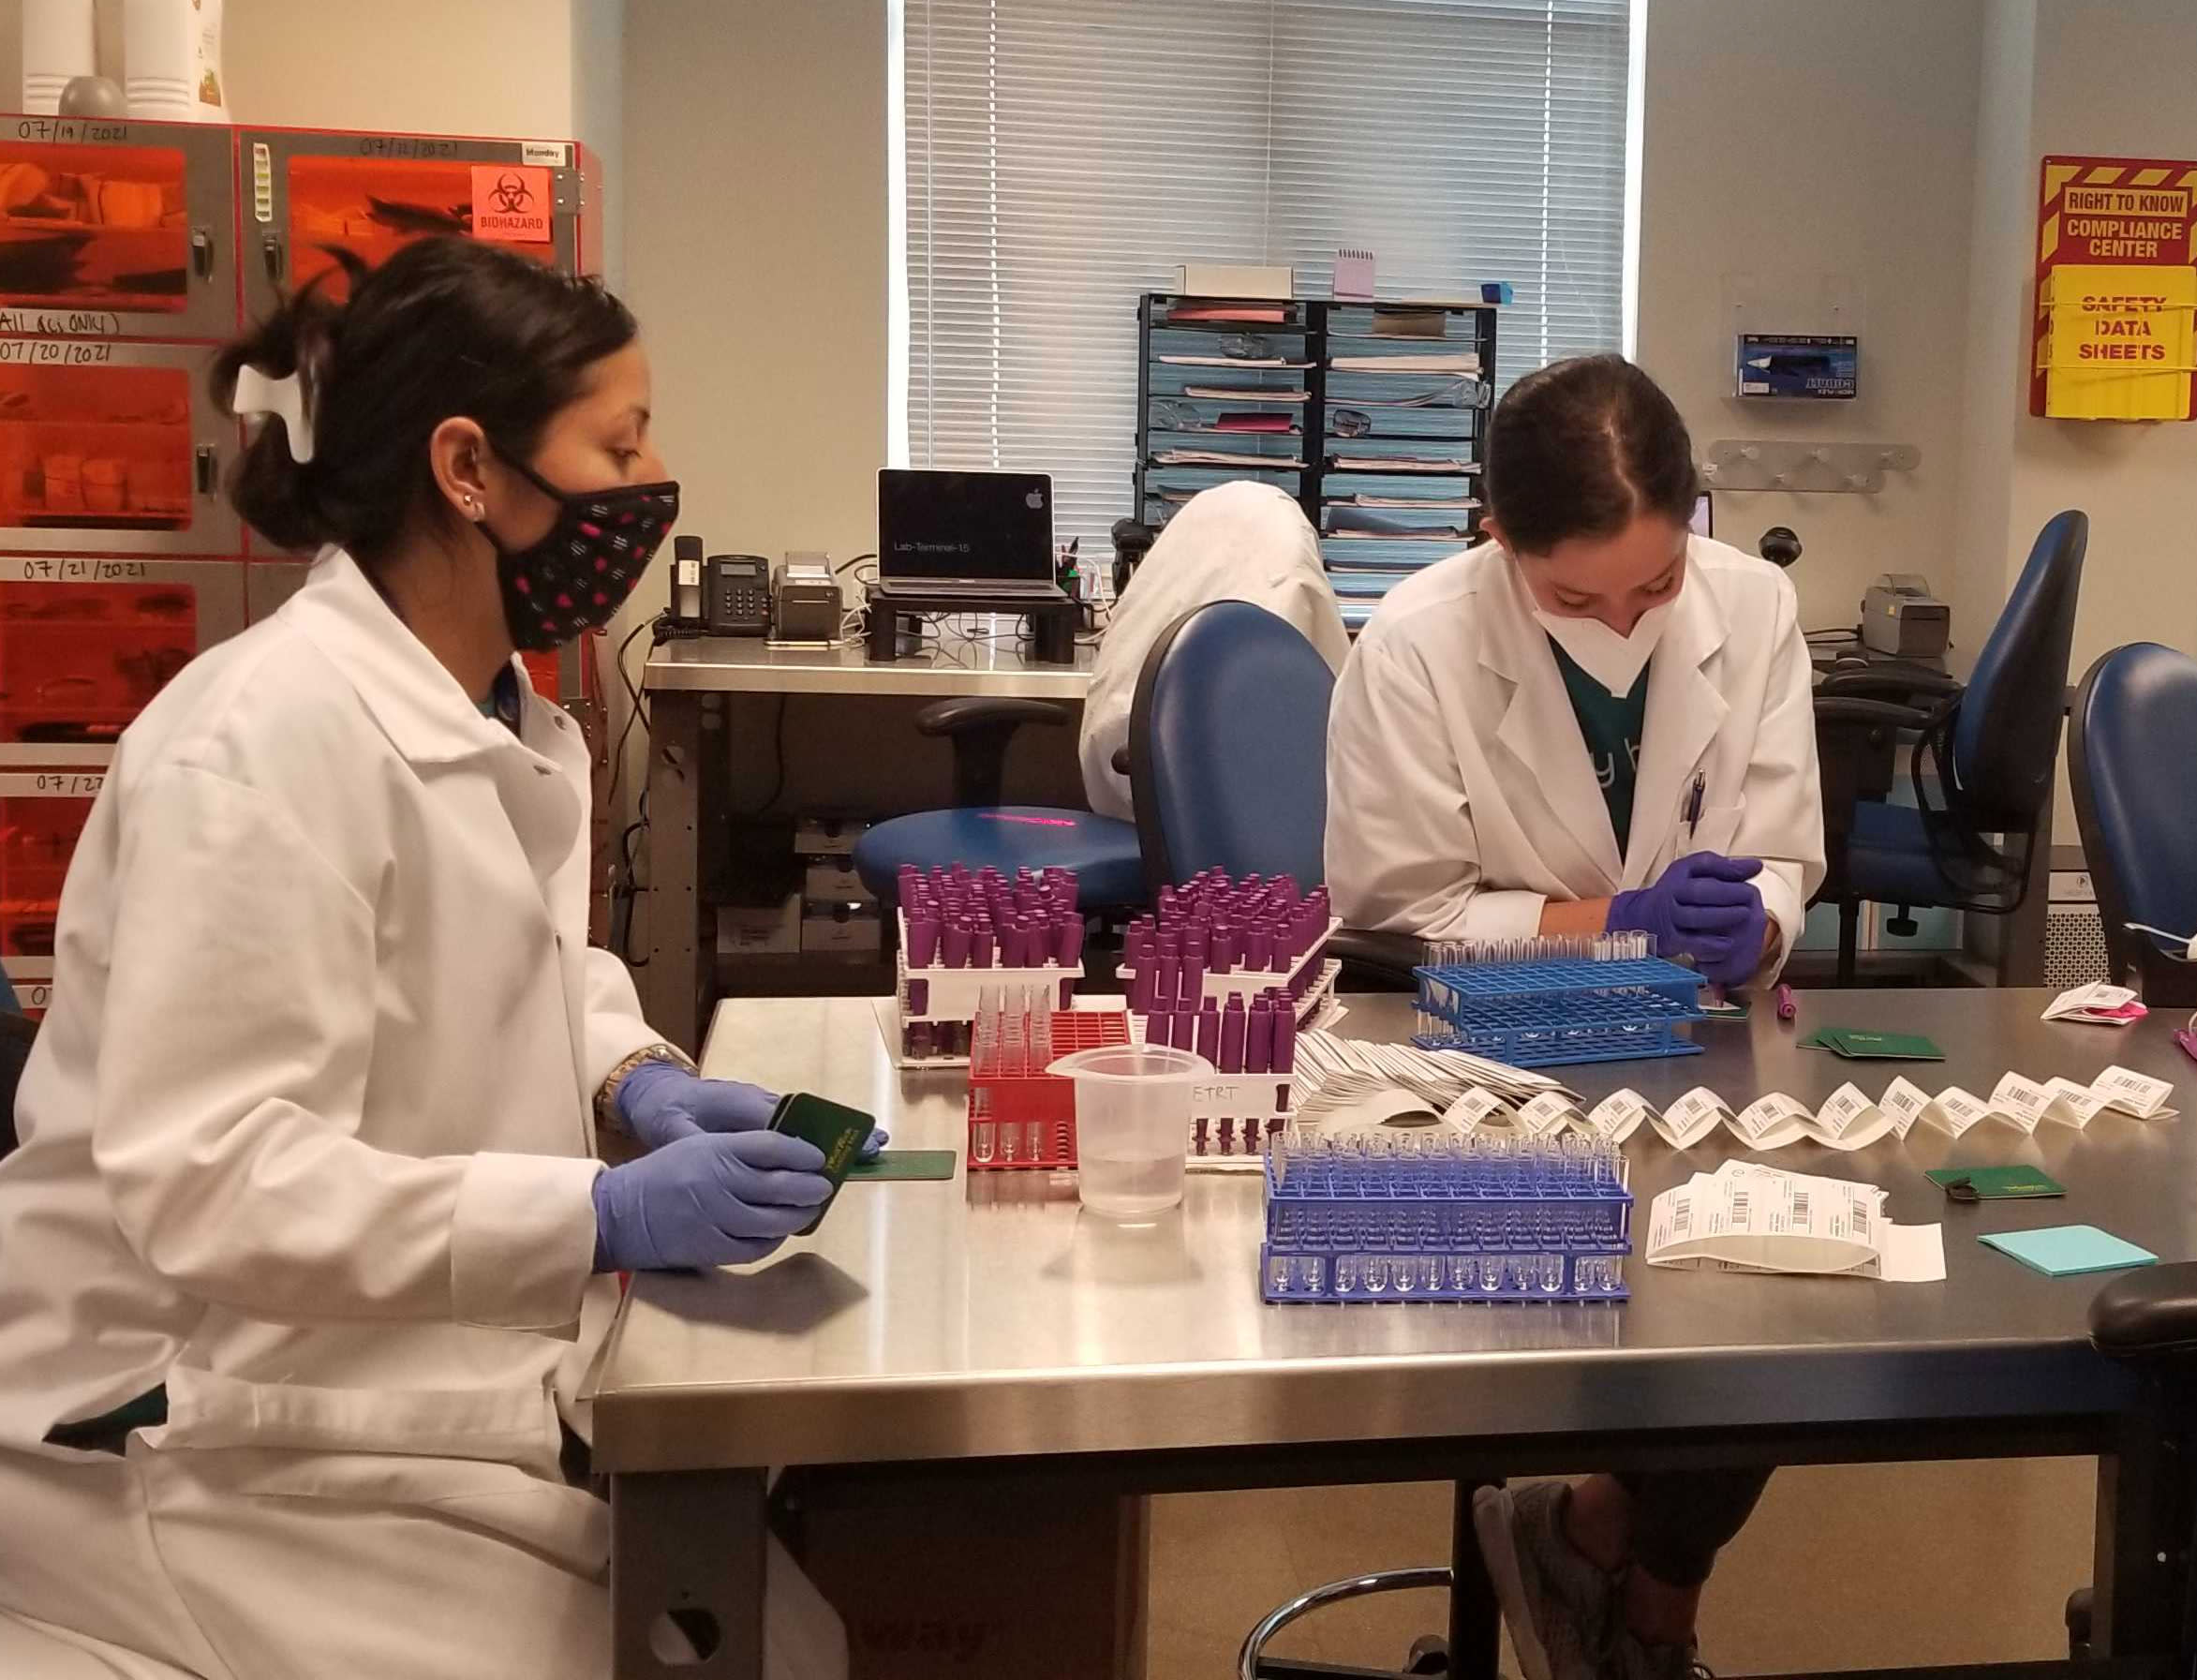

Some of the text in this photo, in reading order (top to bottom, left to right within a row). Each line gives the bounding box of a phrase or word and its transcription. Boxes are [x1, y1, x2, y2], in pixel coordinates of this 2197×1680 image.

[2069, 191, 2184, 213] RIGHT TO KNOW
[481, 216, 543, 230] BIOHAZARD
[2067, 218, 2182, 240] COMPLIANCE
[2089, 239, 2159, 258] CENTER
[2082, 295, 2167, 313] SAFETY
[2095, 320, 2152, 336] DATA
[0, 341, 111, 364] 07/20/2021
[2079, 343, 2165, 361] SHEETS
[24, 558, 146, 580] 07/21/2021
